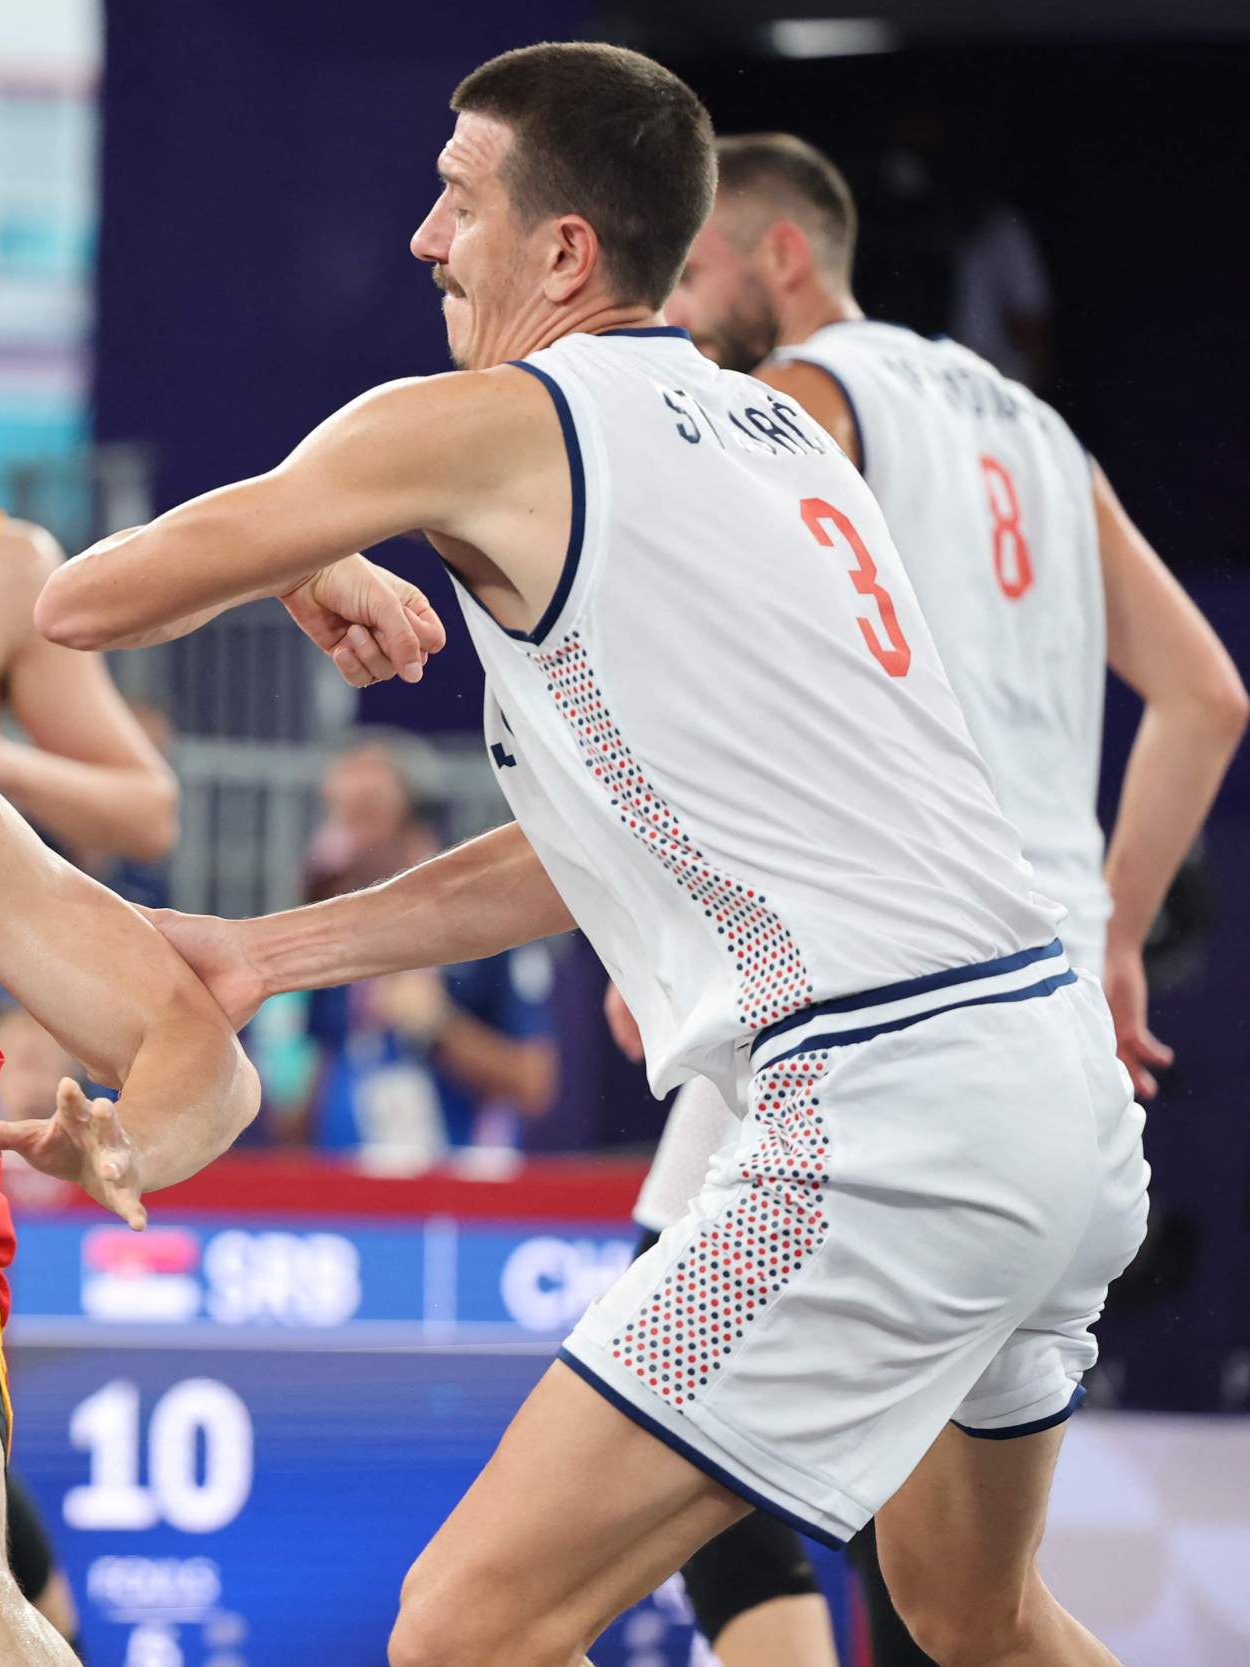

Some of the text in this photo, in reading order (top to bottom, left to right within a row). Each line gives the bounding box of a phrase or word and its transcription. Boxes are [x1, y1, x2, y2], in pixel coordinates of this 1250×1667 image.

[800, 497, 911, 677] 3
[979, 453, 1035, 599] 8
[62, 1377, 253, 1534] 10
